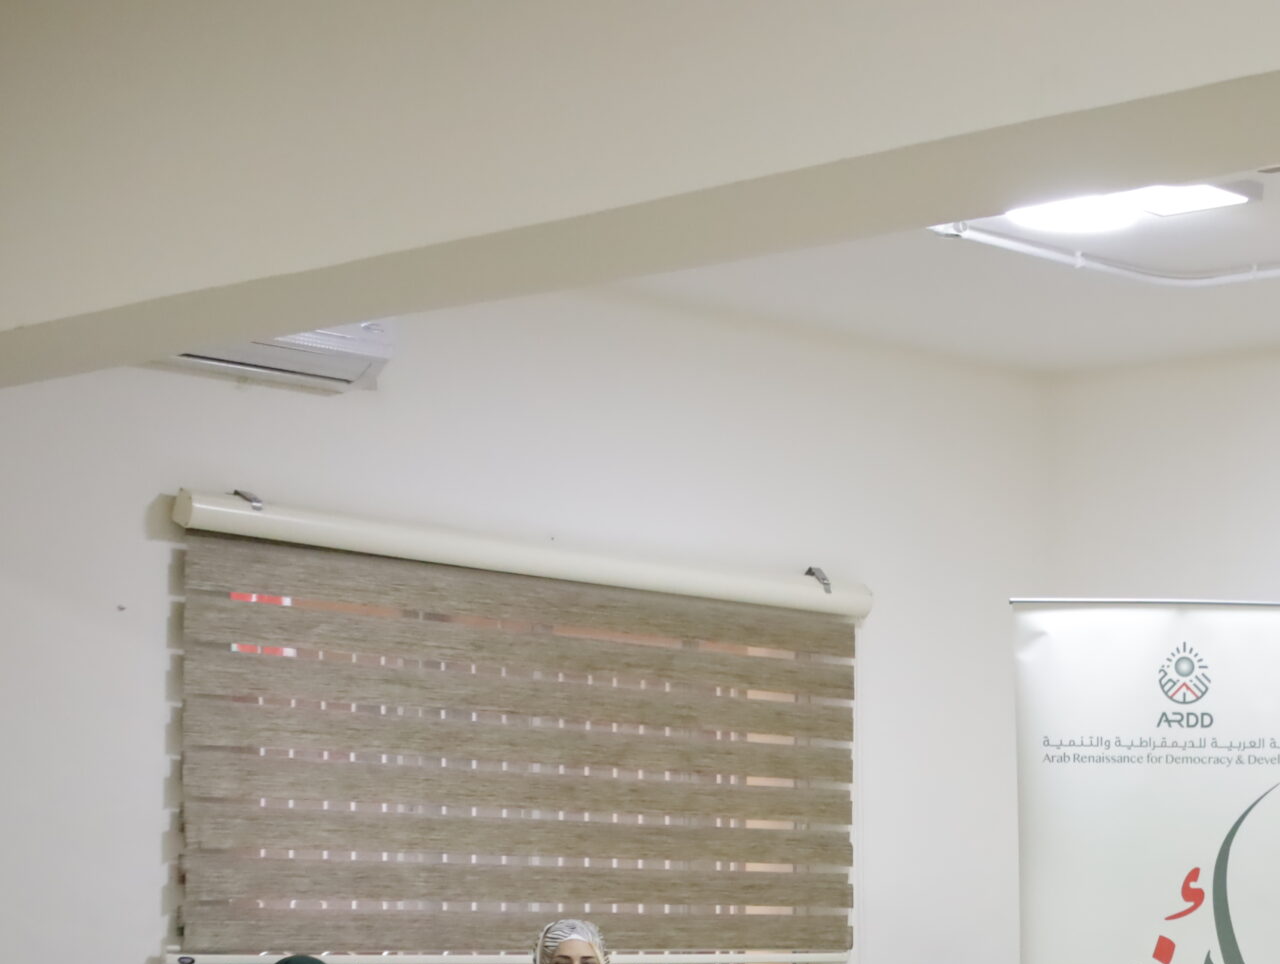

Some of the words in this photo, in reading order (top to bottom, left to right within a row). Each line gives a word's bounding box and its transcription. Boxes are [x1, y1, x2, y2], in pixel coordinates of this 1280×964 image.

[1156, 712, 1214, 729] ARDD
[1042, 735, 1111, 750] والتنمية
[1114, 736, 1207, 751] للديمقراطية
[1210, 737, 1265, 752] العربية
[1042, 752, 1070, 764] Arab
[1073, 752, 1144, 765] Renaissance
[1146, 752, 1163, 765] for
[1165, 753, 1233, 768] Democracy
[1235, 754, 1245, 766] &
